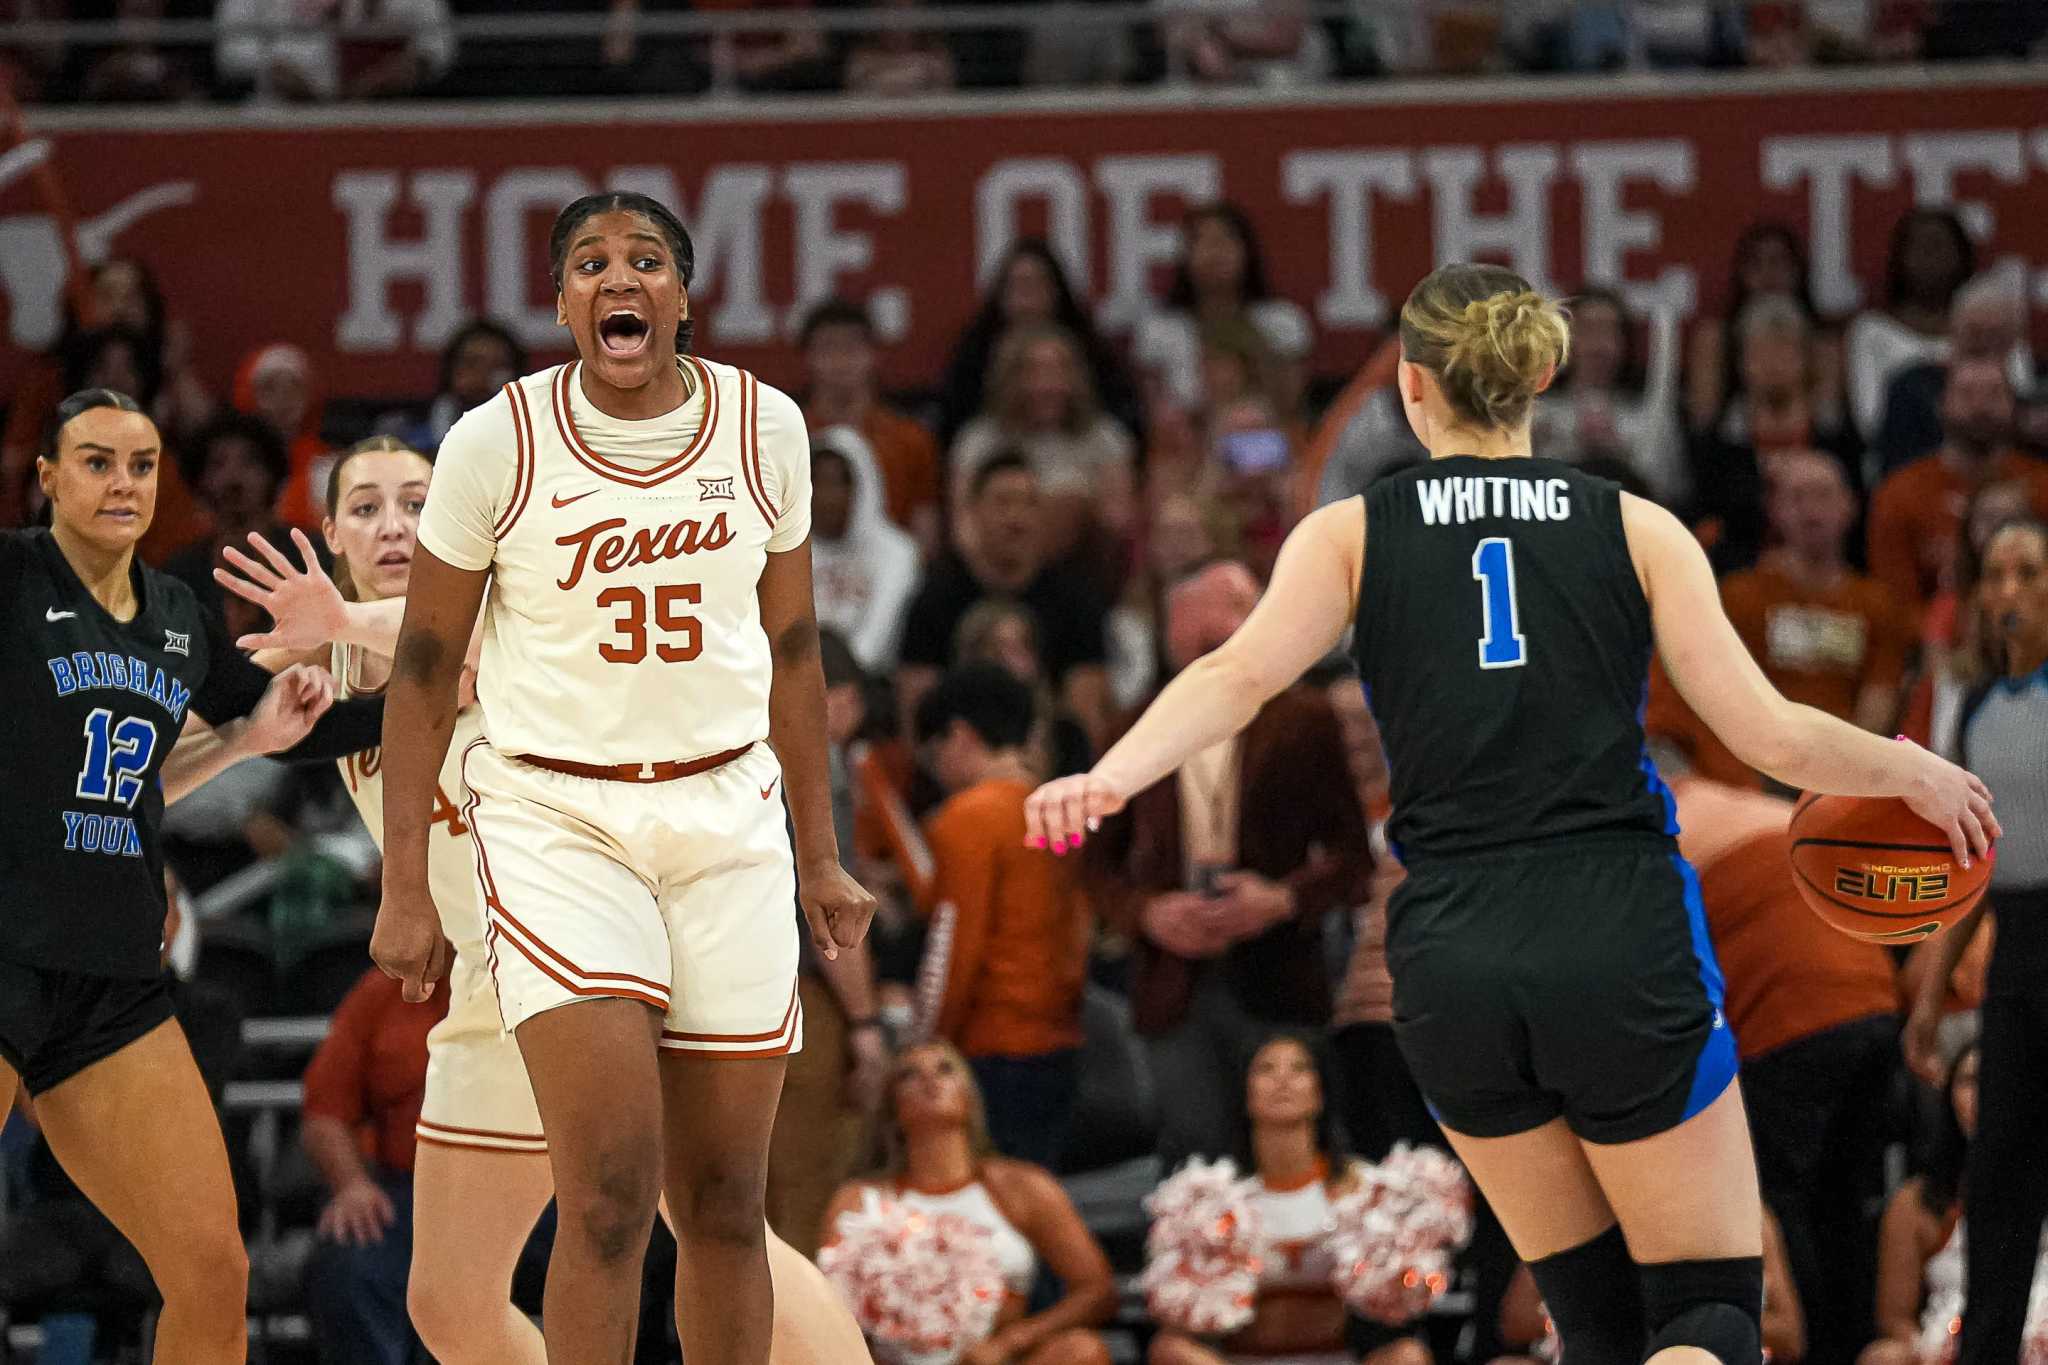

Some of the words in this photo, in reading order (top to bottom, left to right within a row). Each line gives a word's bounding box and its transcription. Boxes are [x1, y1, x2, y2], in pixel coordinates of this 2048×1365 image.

[334, 162, 908, 351] HOME
[973, 154, 1222, 330] OF
[1281, 139, 1695, 328] THE
[1416, 476, 1571, 526] WHITING
[555, 512, 737, 591] Texas
[596, 583, 703, 664] 35
[1472, 537, 1528, 670] 1
[48, 651, 190, 724] BRIGHAM
[76, 707, 157, 811] 12
[1834, 866, 1949, 903] ELITE
